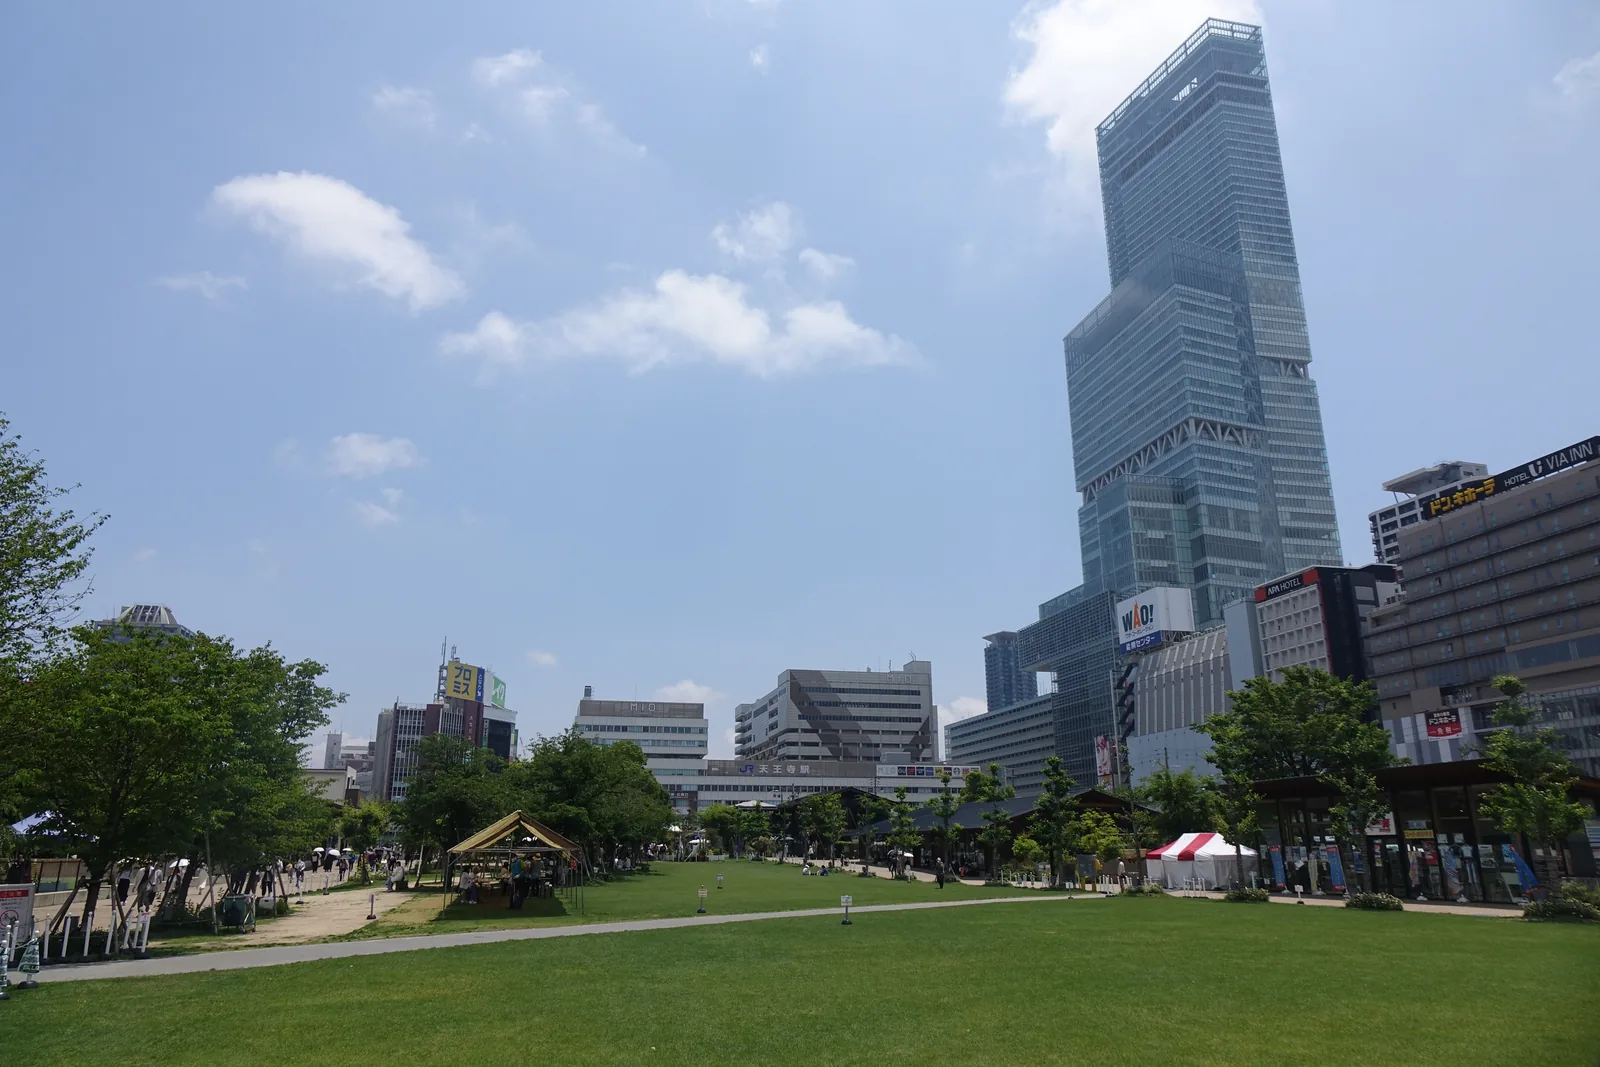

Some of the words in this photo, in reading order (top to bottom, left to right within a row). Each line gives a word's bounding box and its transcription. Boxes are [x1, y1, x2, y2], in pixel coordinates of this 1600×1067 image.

[1504, 473, 1531, 487] HOTEL
[1545, 452, 1569, 470] VIA
[1569, 442, 1593, 462] INN
[1267, 585, 1280, 596] APA
[1280, 577, 1302, 591] HOTEL
[1122, 599, 1154, 633] WAO!
[630, 702, 656, 712] MIO
[739, 764, 755, 773] JR
[759, 764, 810, 774] 天王寺駅
